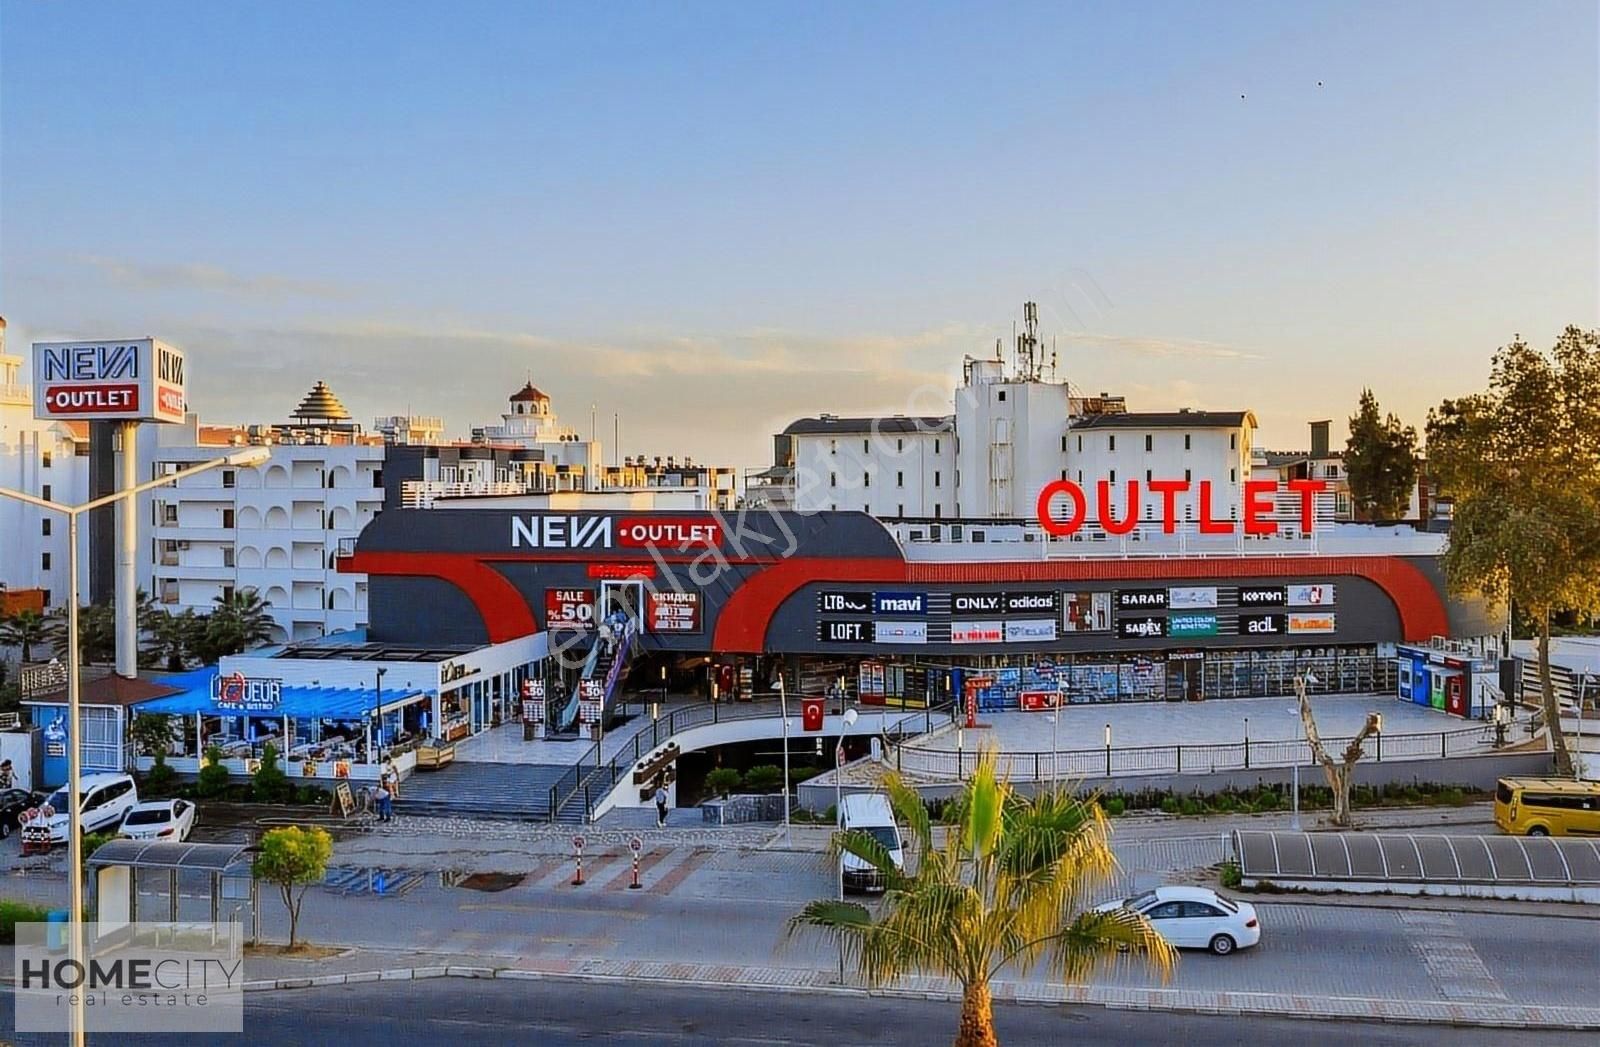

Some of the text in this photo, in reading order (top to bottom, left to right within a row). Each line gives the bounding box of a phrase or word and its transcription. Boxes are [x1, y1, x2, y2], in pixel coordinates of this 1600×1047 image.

[44, 346, 138, 380] NEVA
[56, 390, 133, 407] OUTLET
[1037, 479, 1327, 536] OUTLET
[511, 516, 717, 548] NEVA OUTLET
[556, 591, 585, 601] SALE
[824, 595, 845, 610] LTB
[881, 596, 921, 611] mavi
[1009, 595, 1053, 608] adidas
[1122, 594, 1164, 605] SARAR
